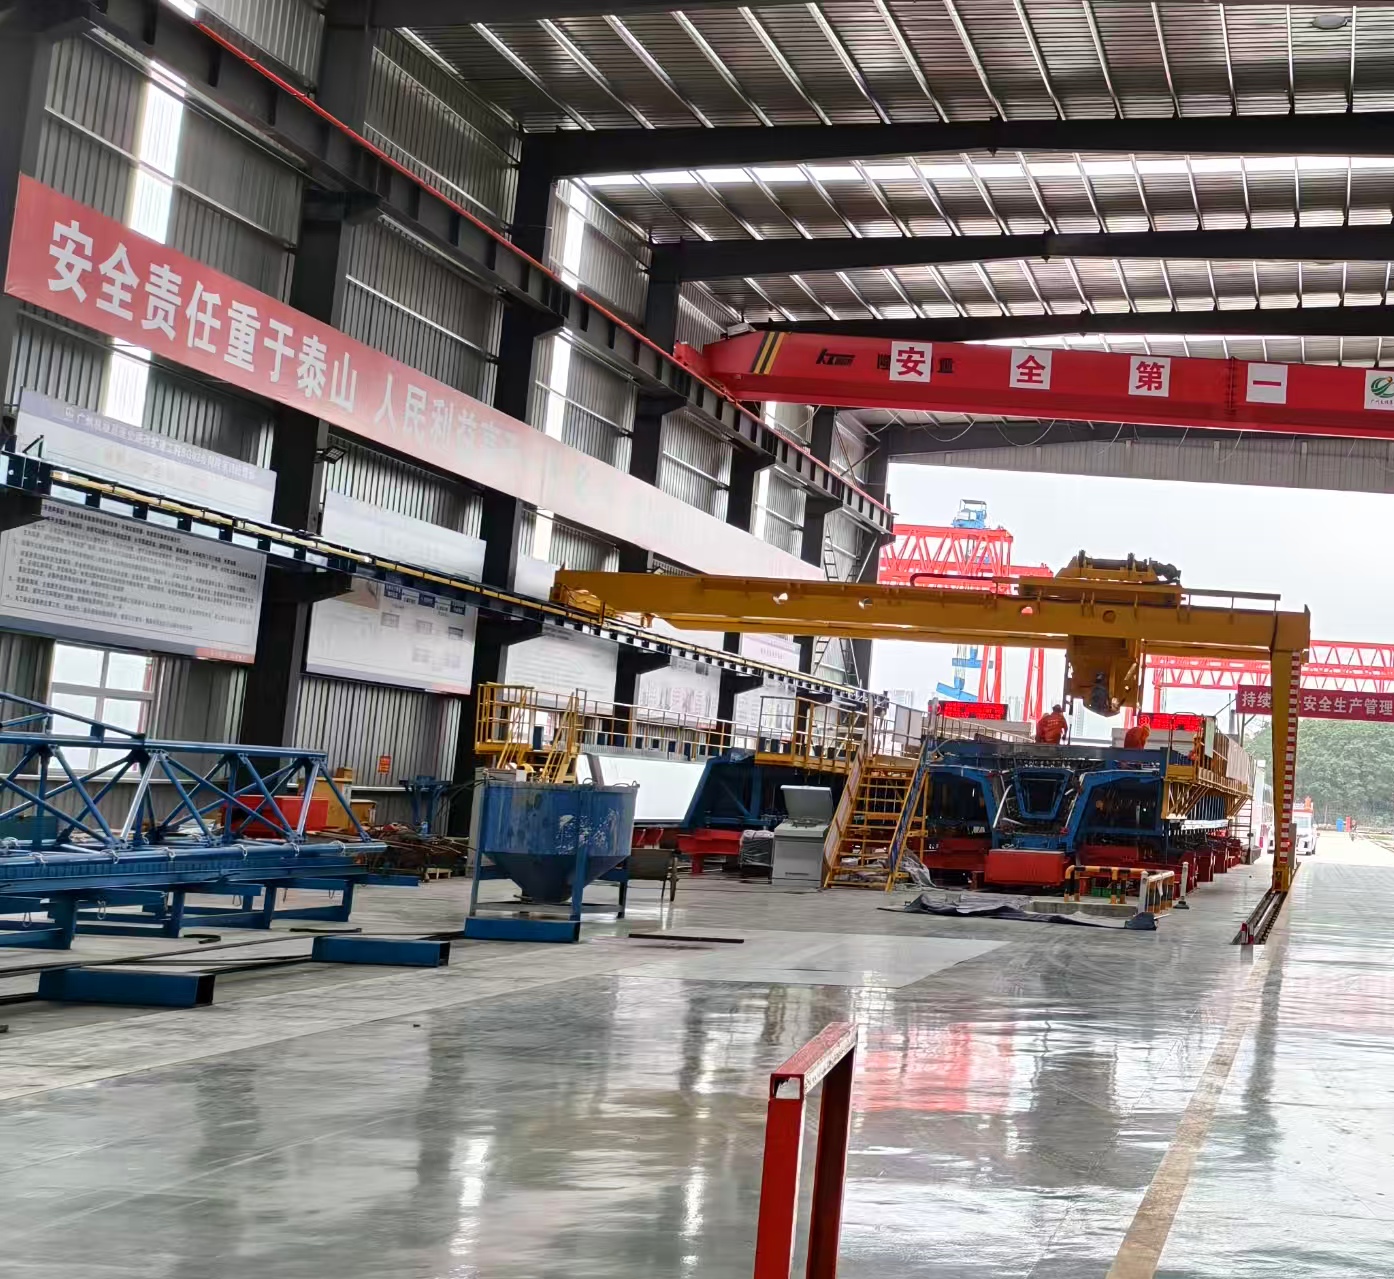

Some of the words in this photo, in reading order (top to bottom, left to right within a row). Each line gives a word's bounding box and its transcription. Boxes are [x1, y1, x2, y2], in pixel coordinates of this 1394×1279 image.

[48, 220, 357, 413] 安全责任重于泰山
[1242, 690, 1393, 716] 持续安全生产管理
